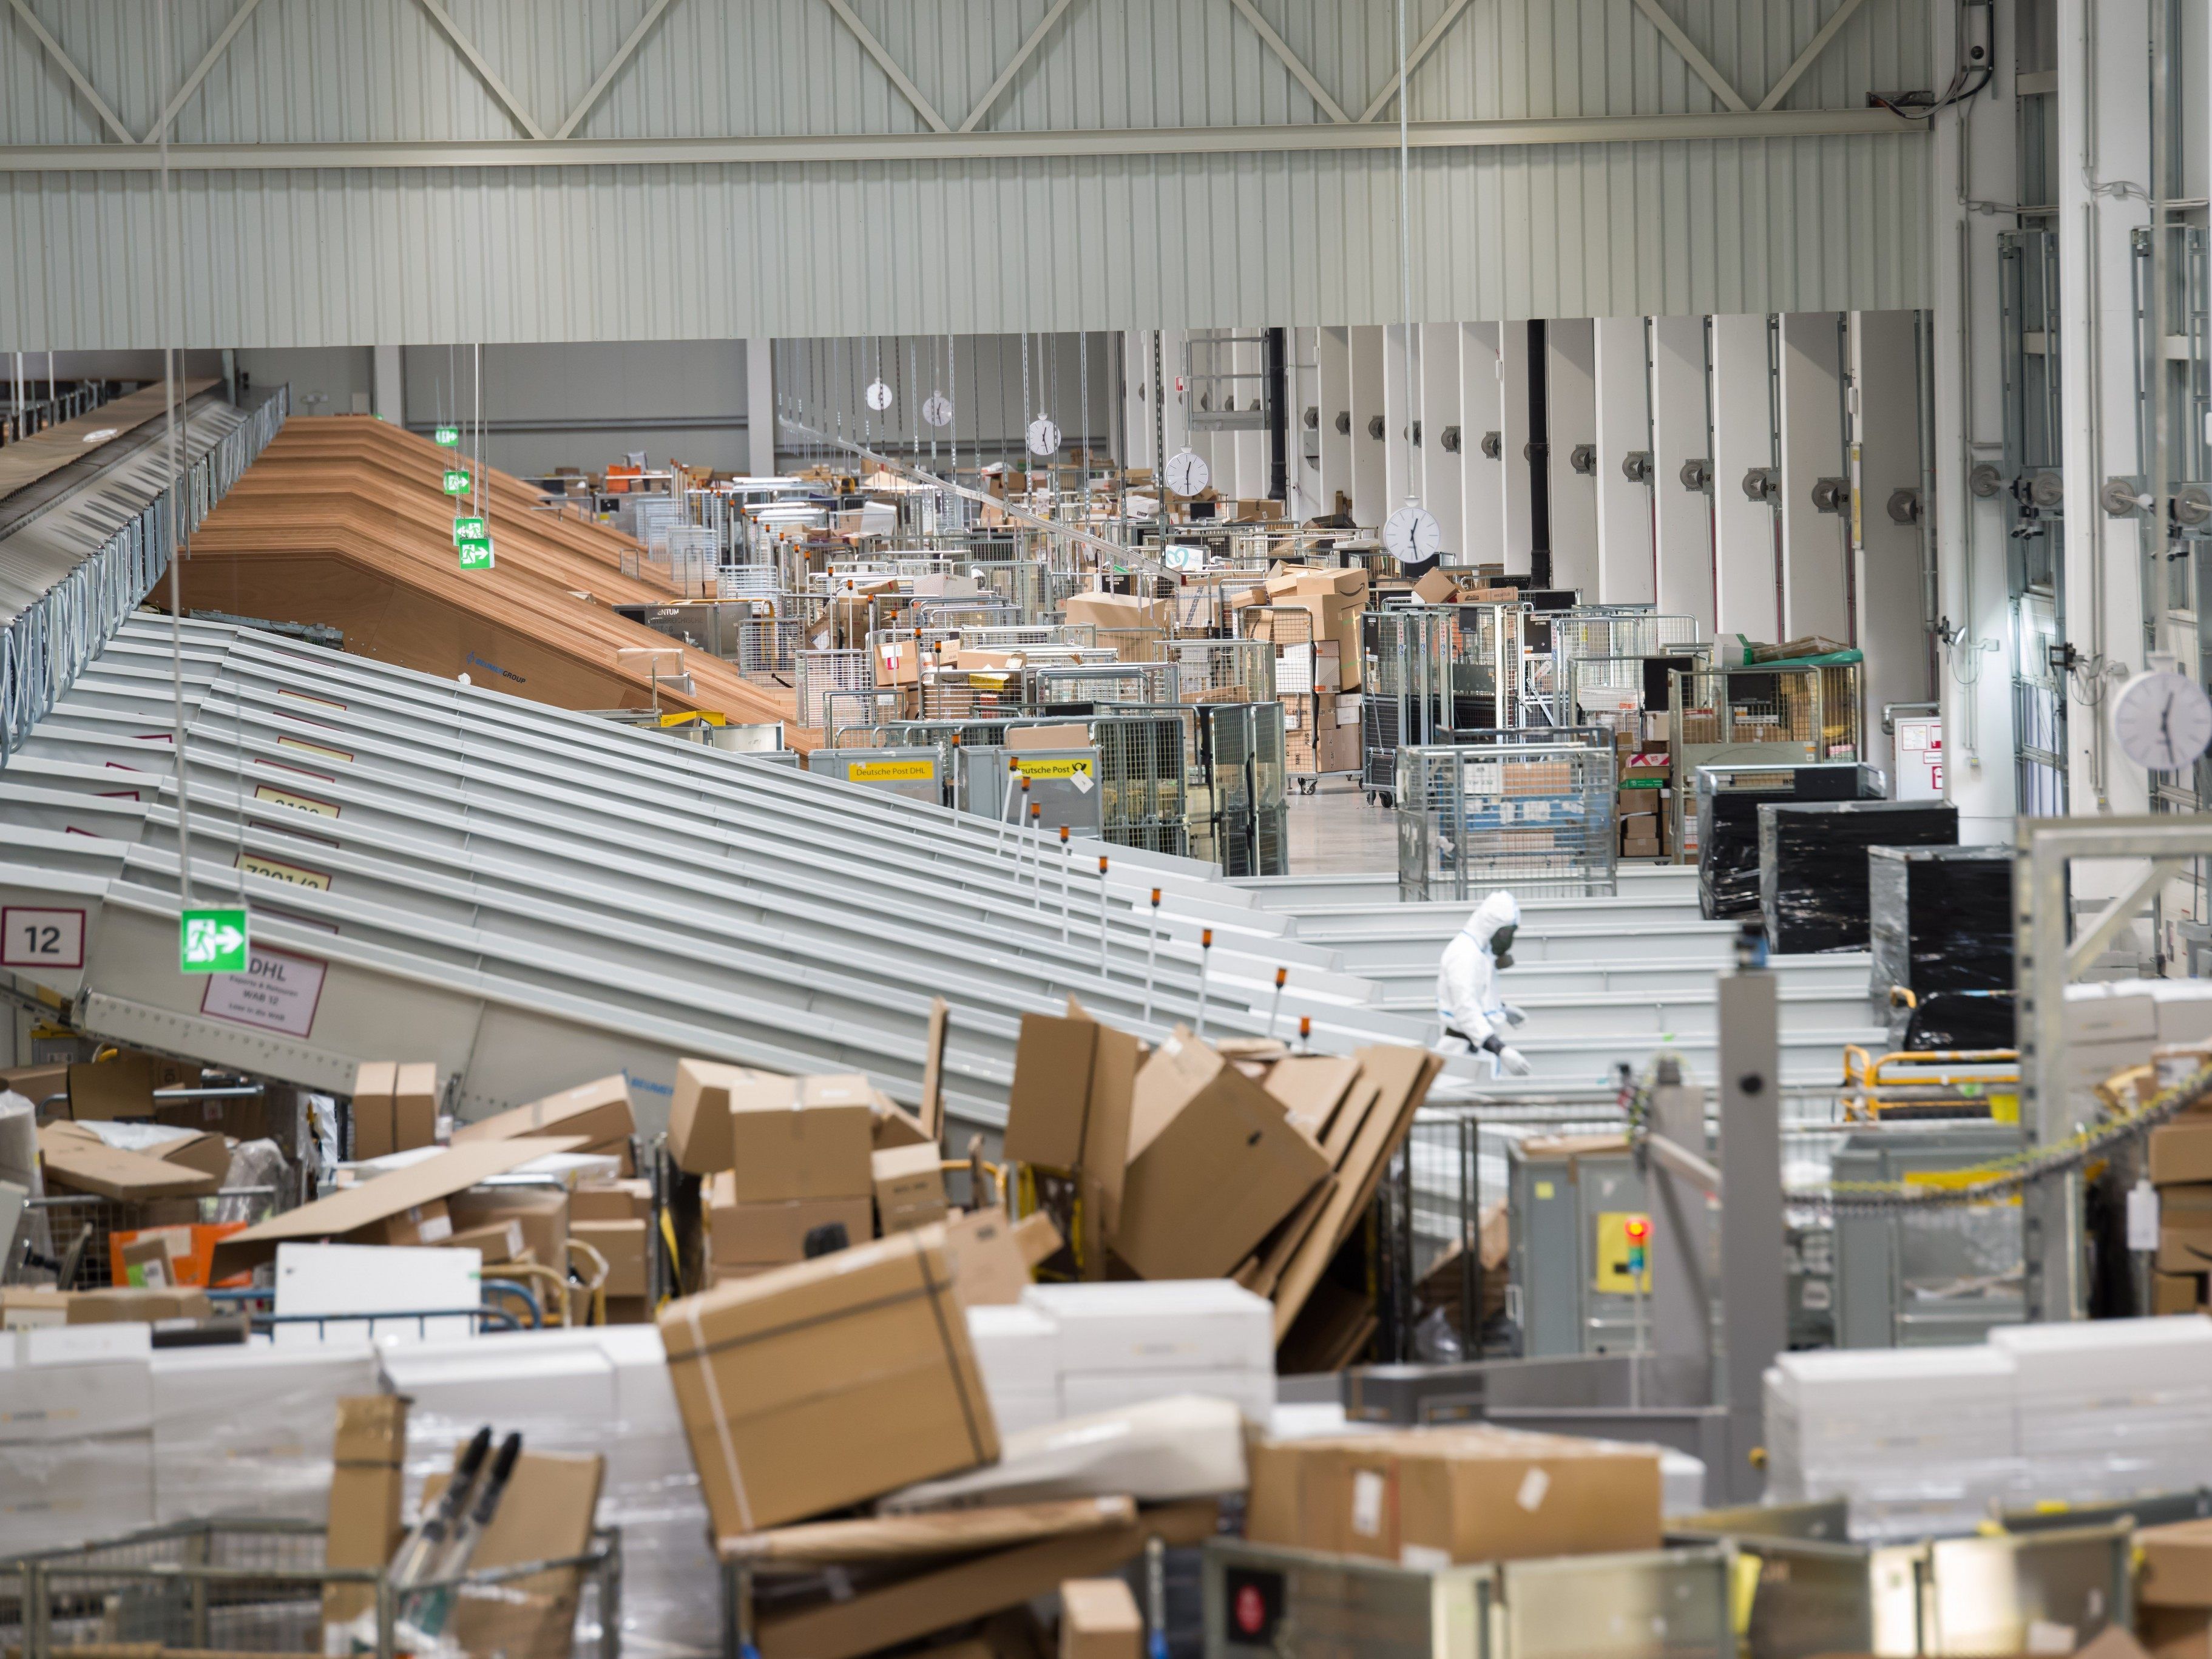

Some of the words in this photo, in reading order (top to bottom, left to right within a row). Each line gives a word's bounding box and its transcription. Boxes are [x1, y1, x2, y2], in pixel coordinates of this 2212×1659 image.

[856, 768, 891, 776] Deutsche
[25, 926, 60, 953] 12
[248, 958, 286, 982] DHL
